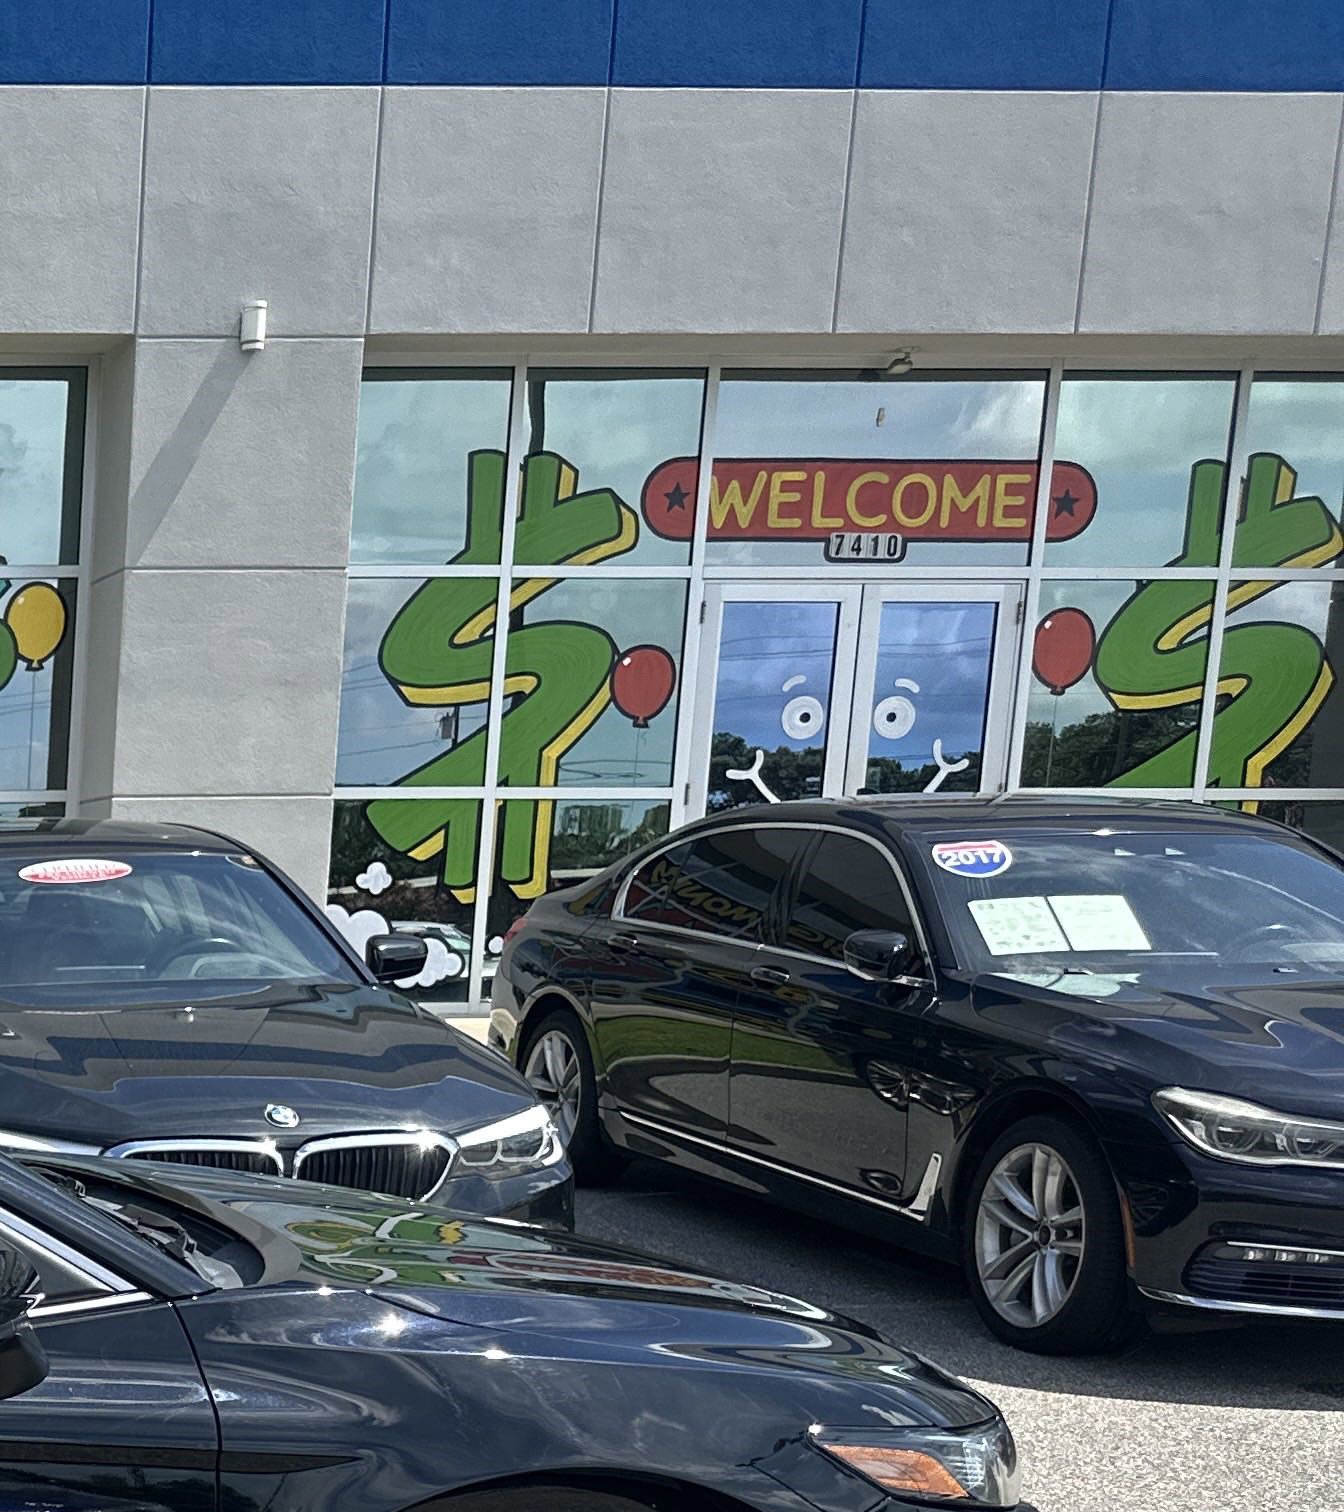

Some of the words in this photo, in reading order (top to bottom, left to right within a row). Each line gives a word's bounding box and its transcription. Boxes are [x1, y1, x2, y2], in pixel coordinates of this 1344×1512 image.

[709, 470, 1032, 529] WELCOME
[833, 534, 898, 558] 7410
[941, 848, 1003, 867] 2017
